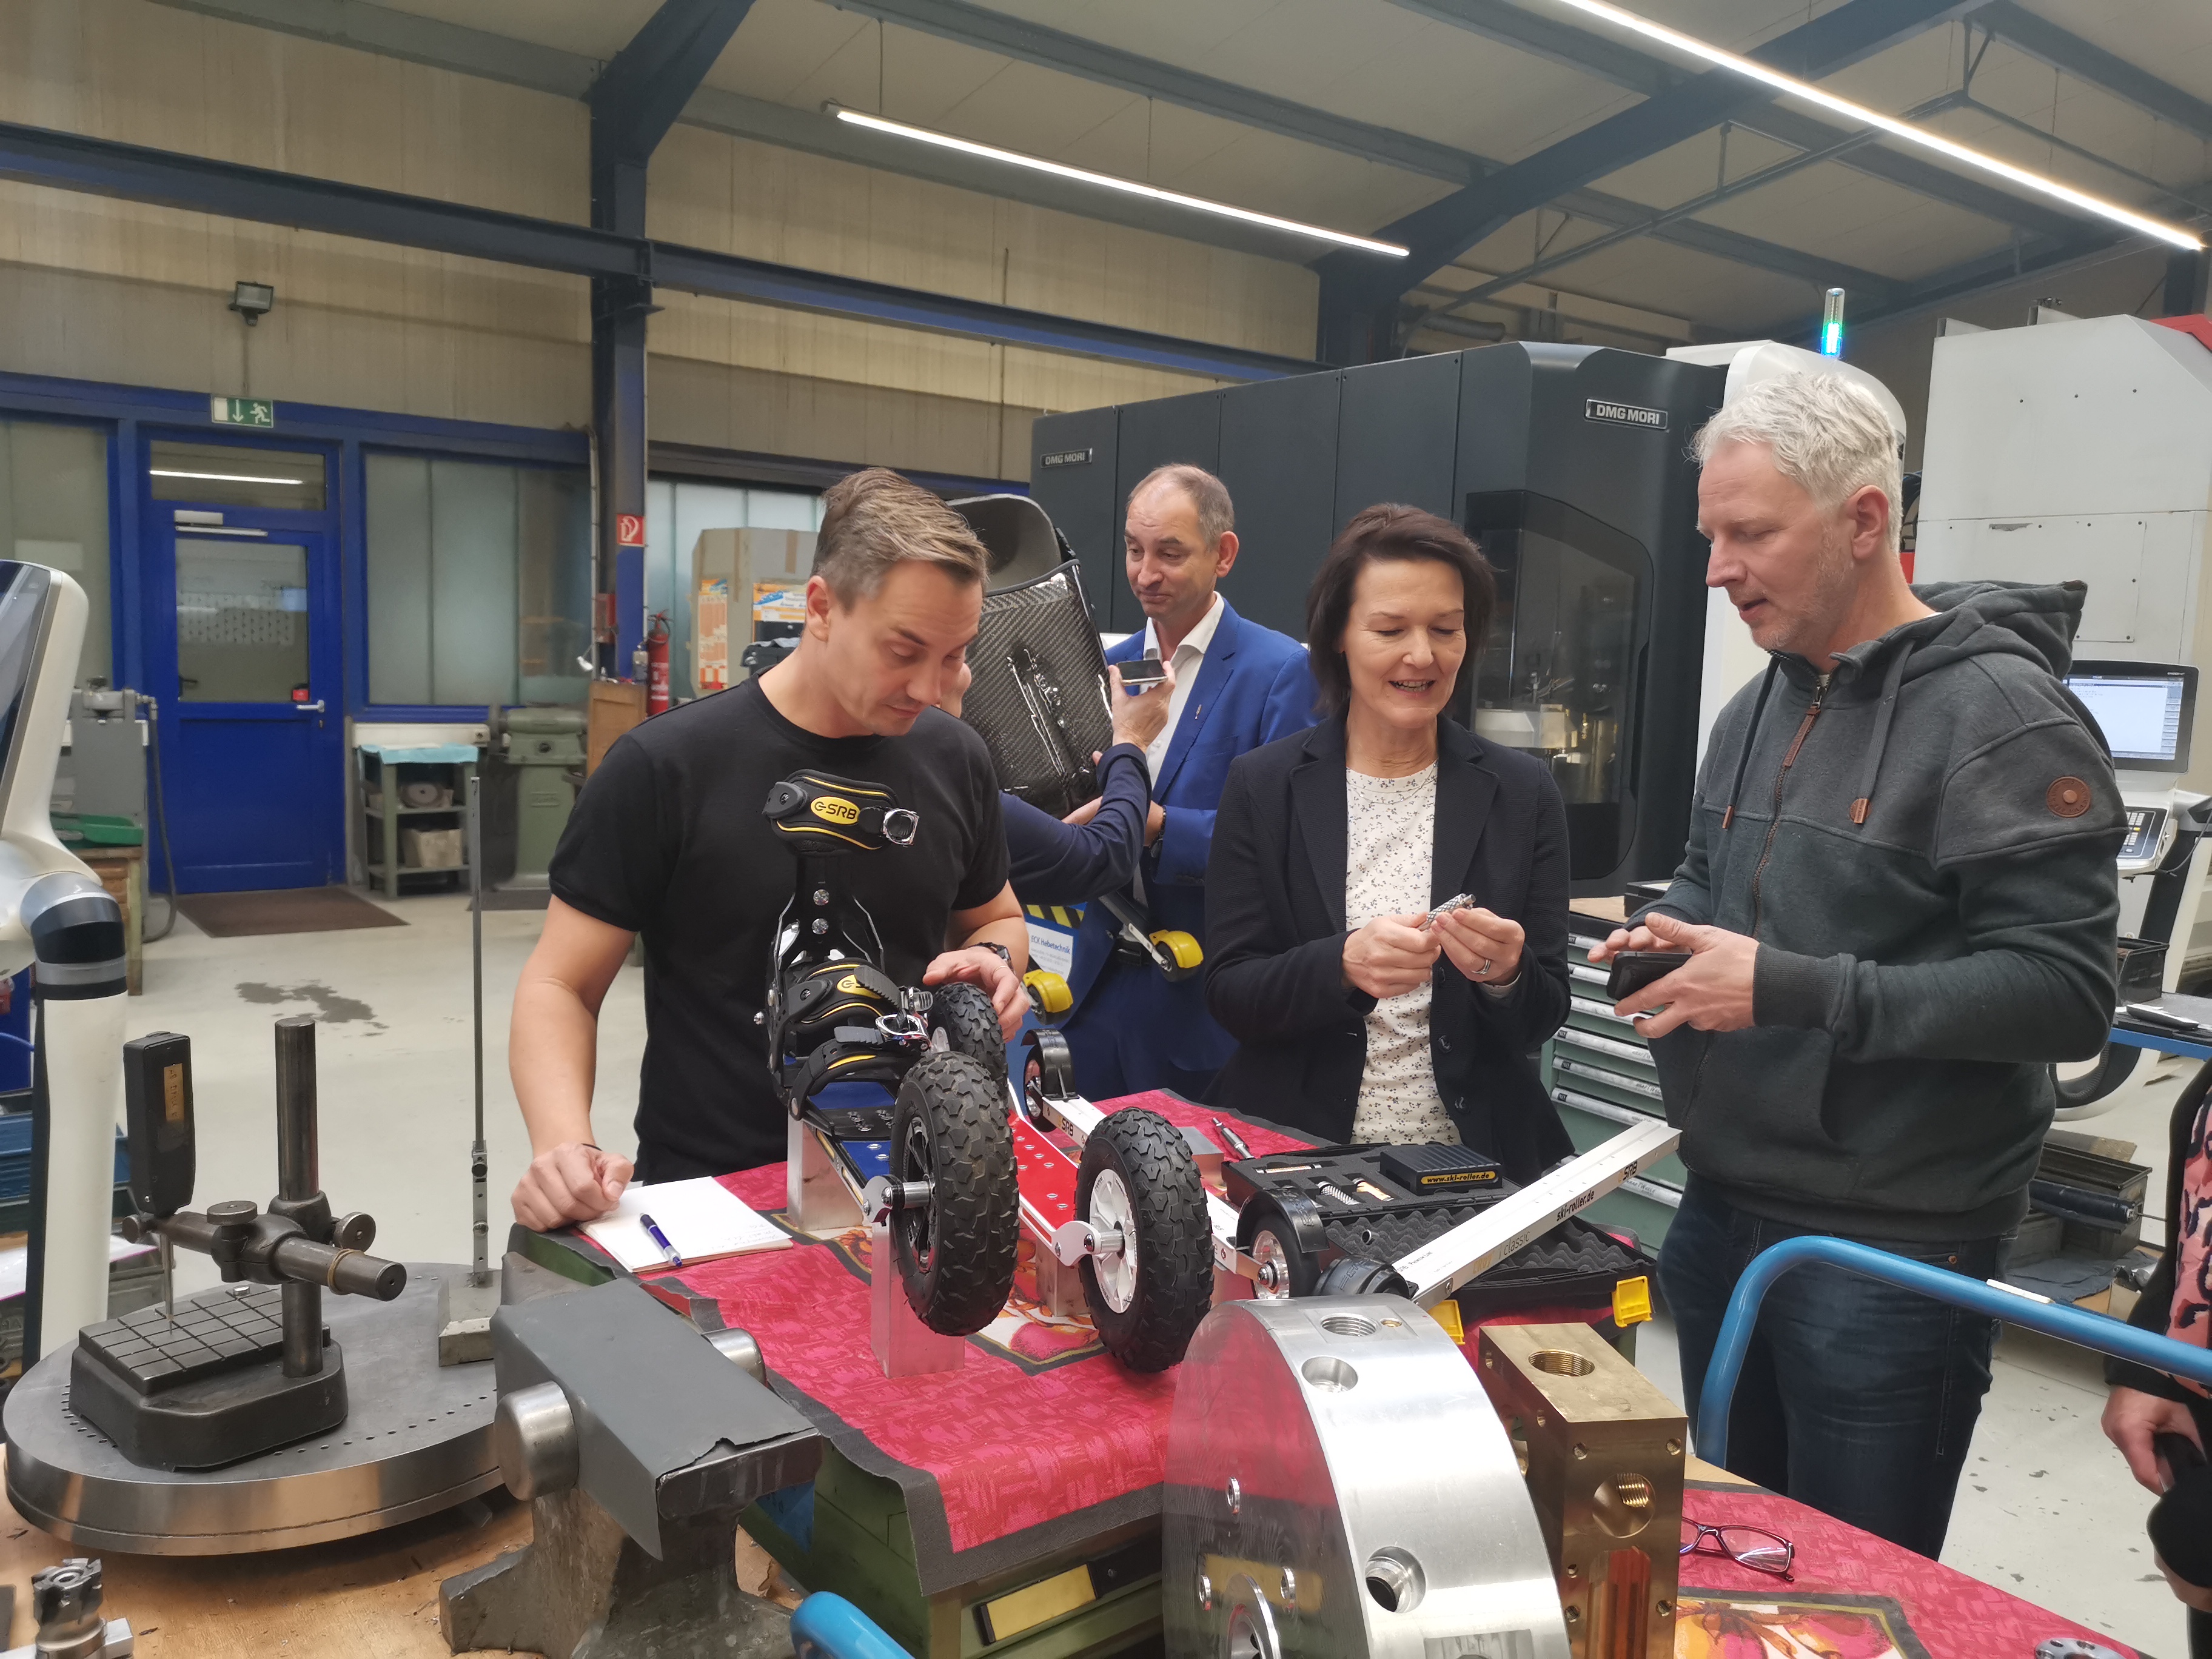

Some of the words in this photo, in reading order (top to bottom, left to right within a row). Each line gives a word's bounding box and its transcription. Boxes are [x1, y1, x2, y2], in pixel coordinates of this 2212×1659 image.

[1596, 404, 1626, 420] DMG
[1627, 409, 1660, 425] MORI
[1045, 454, 1064, 465] DMG
[1064, 452, 1085, 463] MORI
[1427, 1172, 1490, 1183] www.ski-roller.de
[1557, 1189, 1595, 1222] ski-roller.de
[1504, 1231, 1530, 1256] classic
